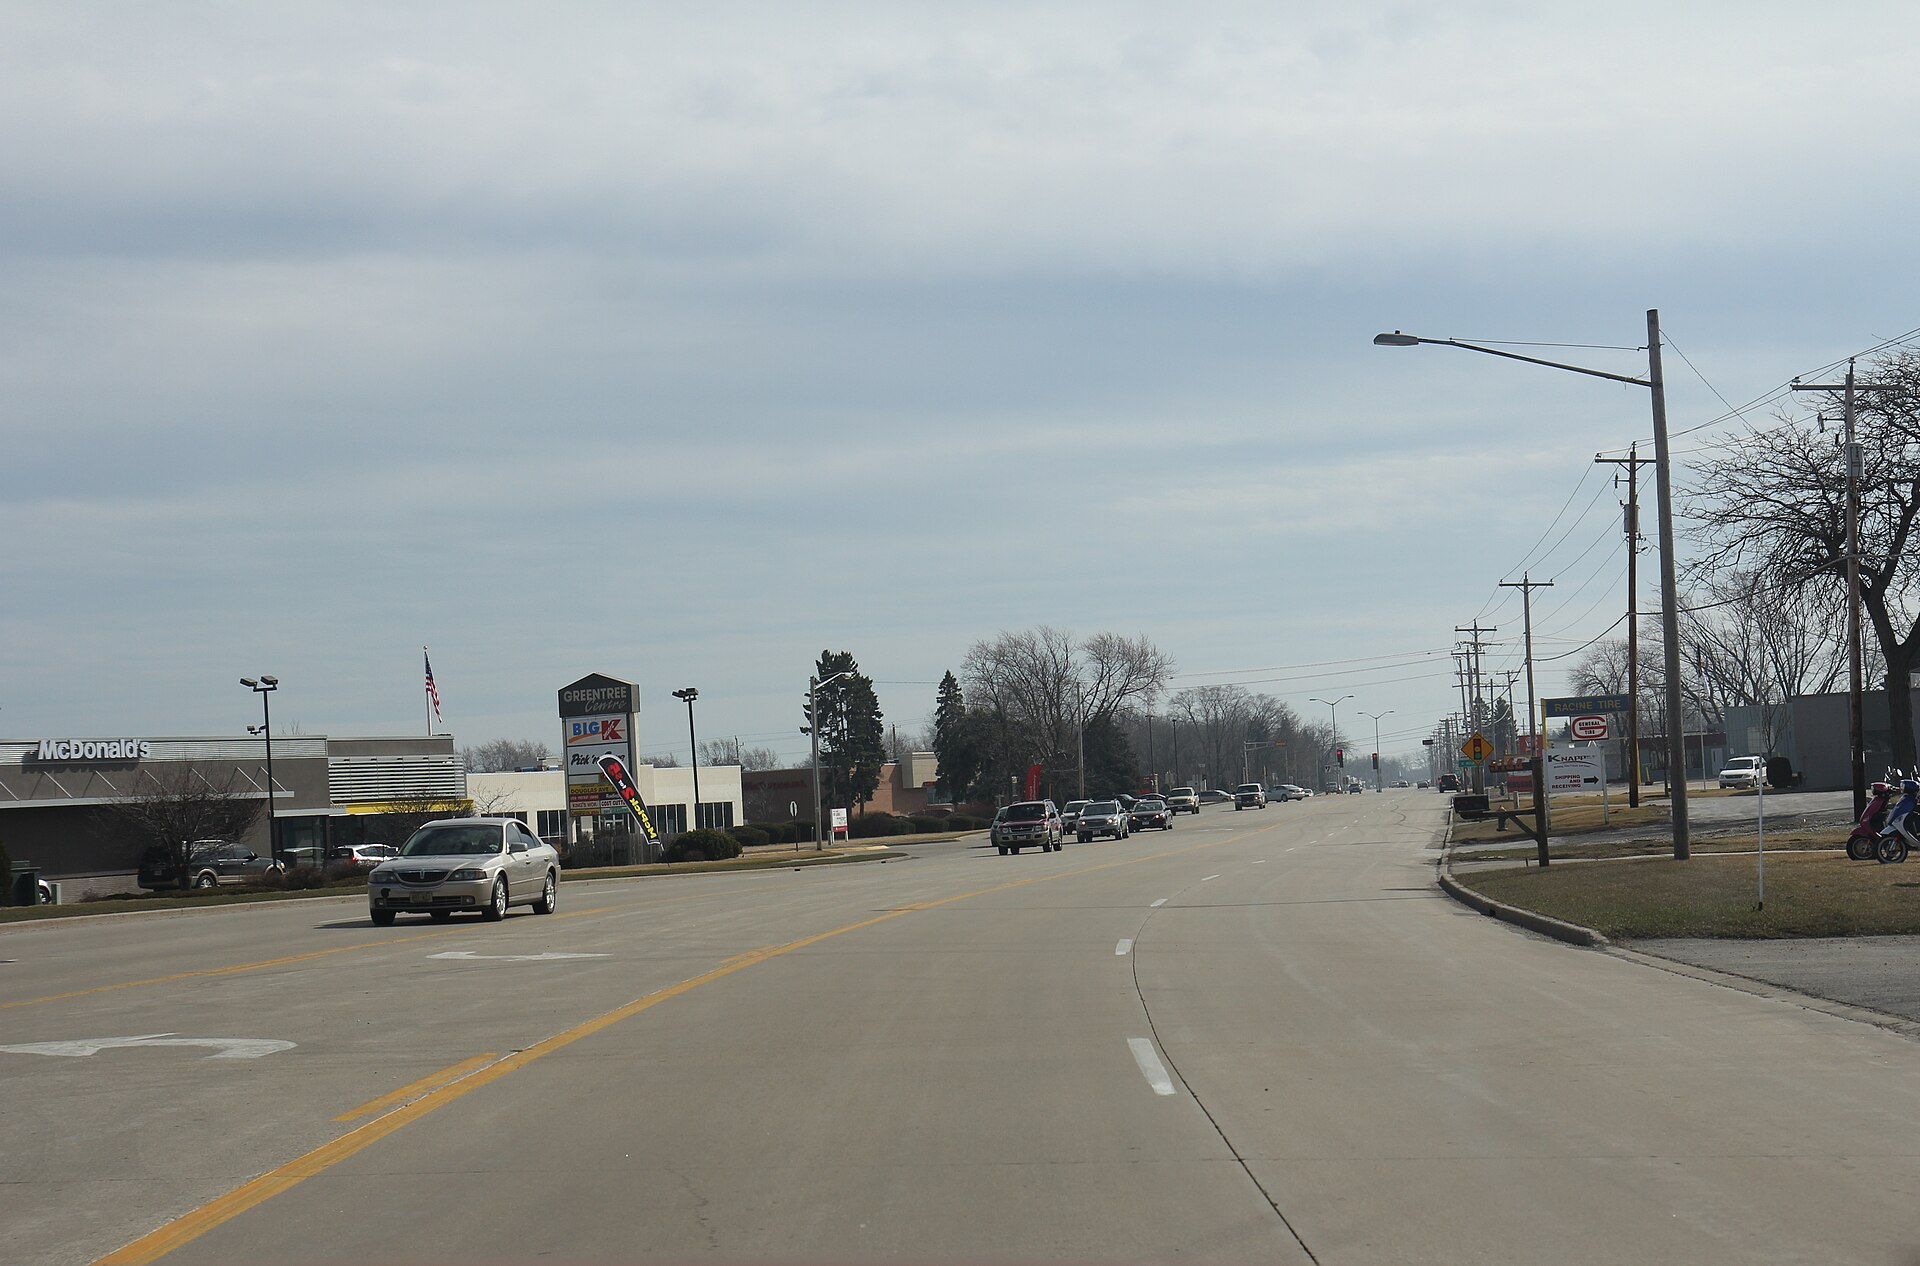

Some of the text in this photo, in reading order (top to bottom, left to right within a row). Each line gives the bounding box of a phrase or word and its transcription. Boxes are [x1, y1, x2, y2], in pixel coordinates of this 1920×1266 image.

[563, 687, 627, 702] GREENTREE
[585, 697, 627, 712] Centre
[1554, 699, 1622, 712] RACINE TIRE
[572, 721, 600, 736] BIG
[37, 738, 152, 760] McDonald's
[570, 753, 591, 766] Pick
[571, 785, 598, 794] DOUGLAS
